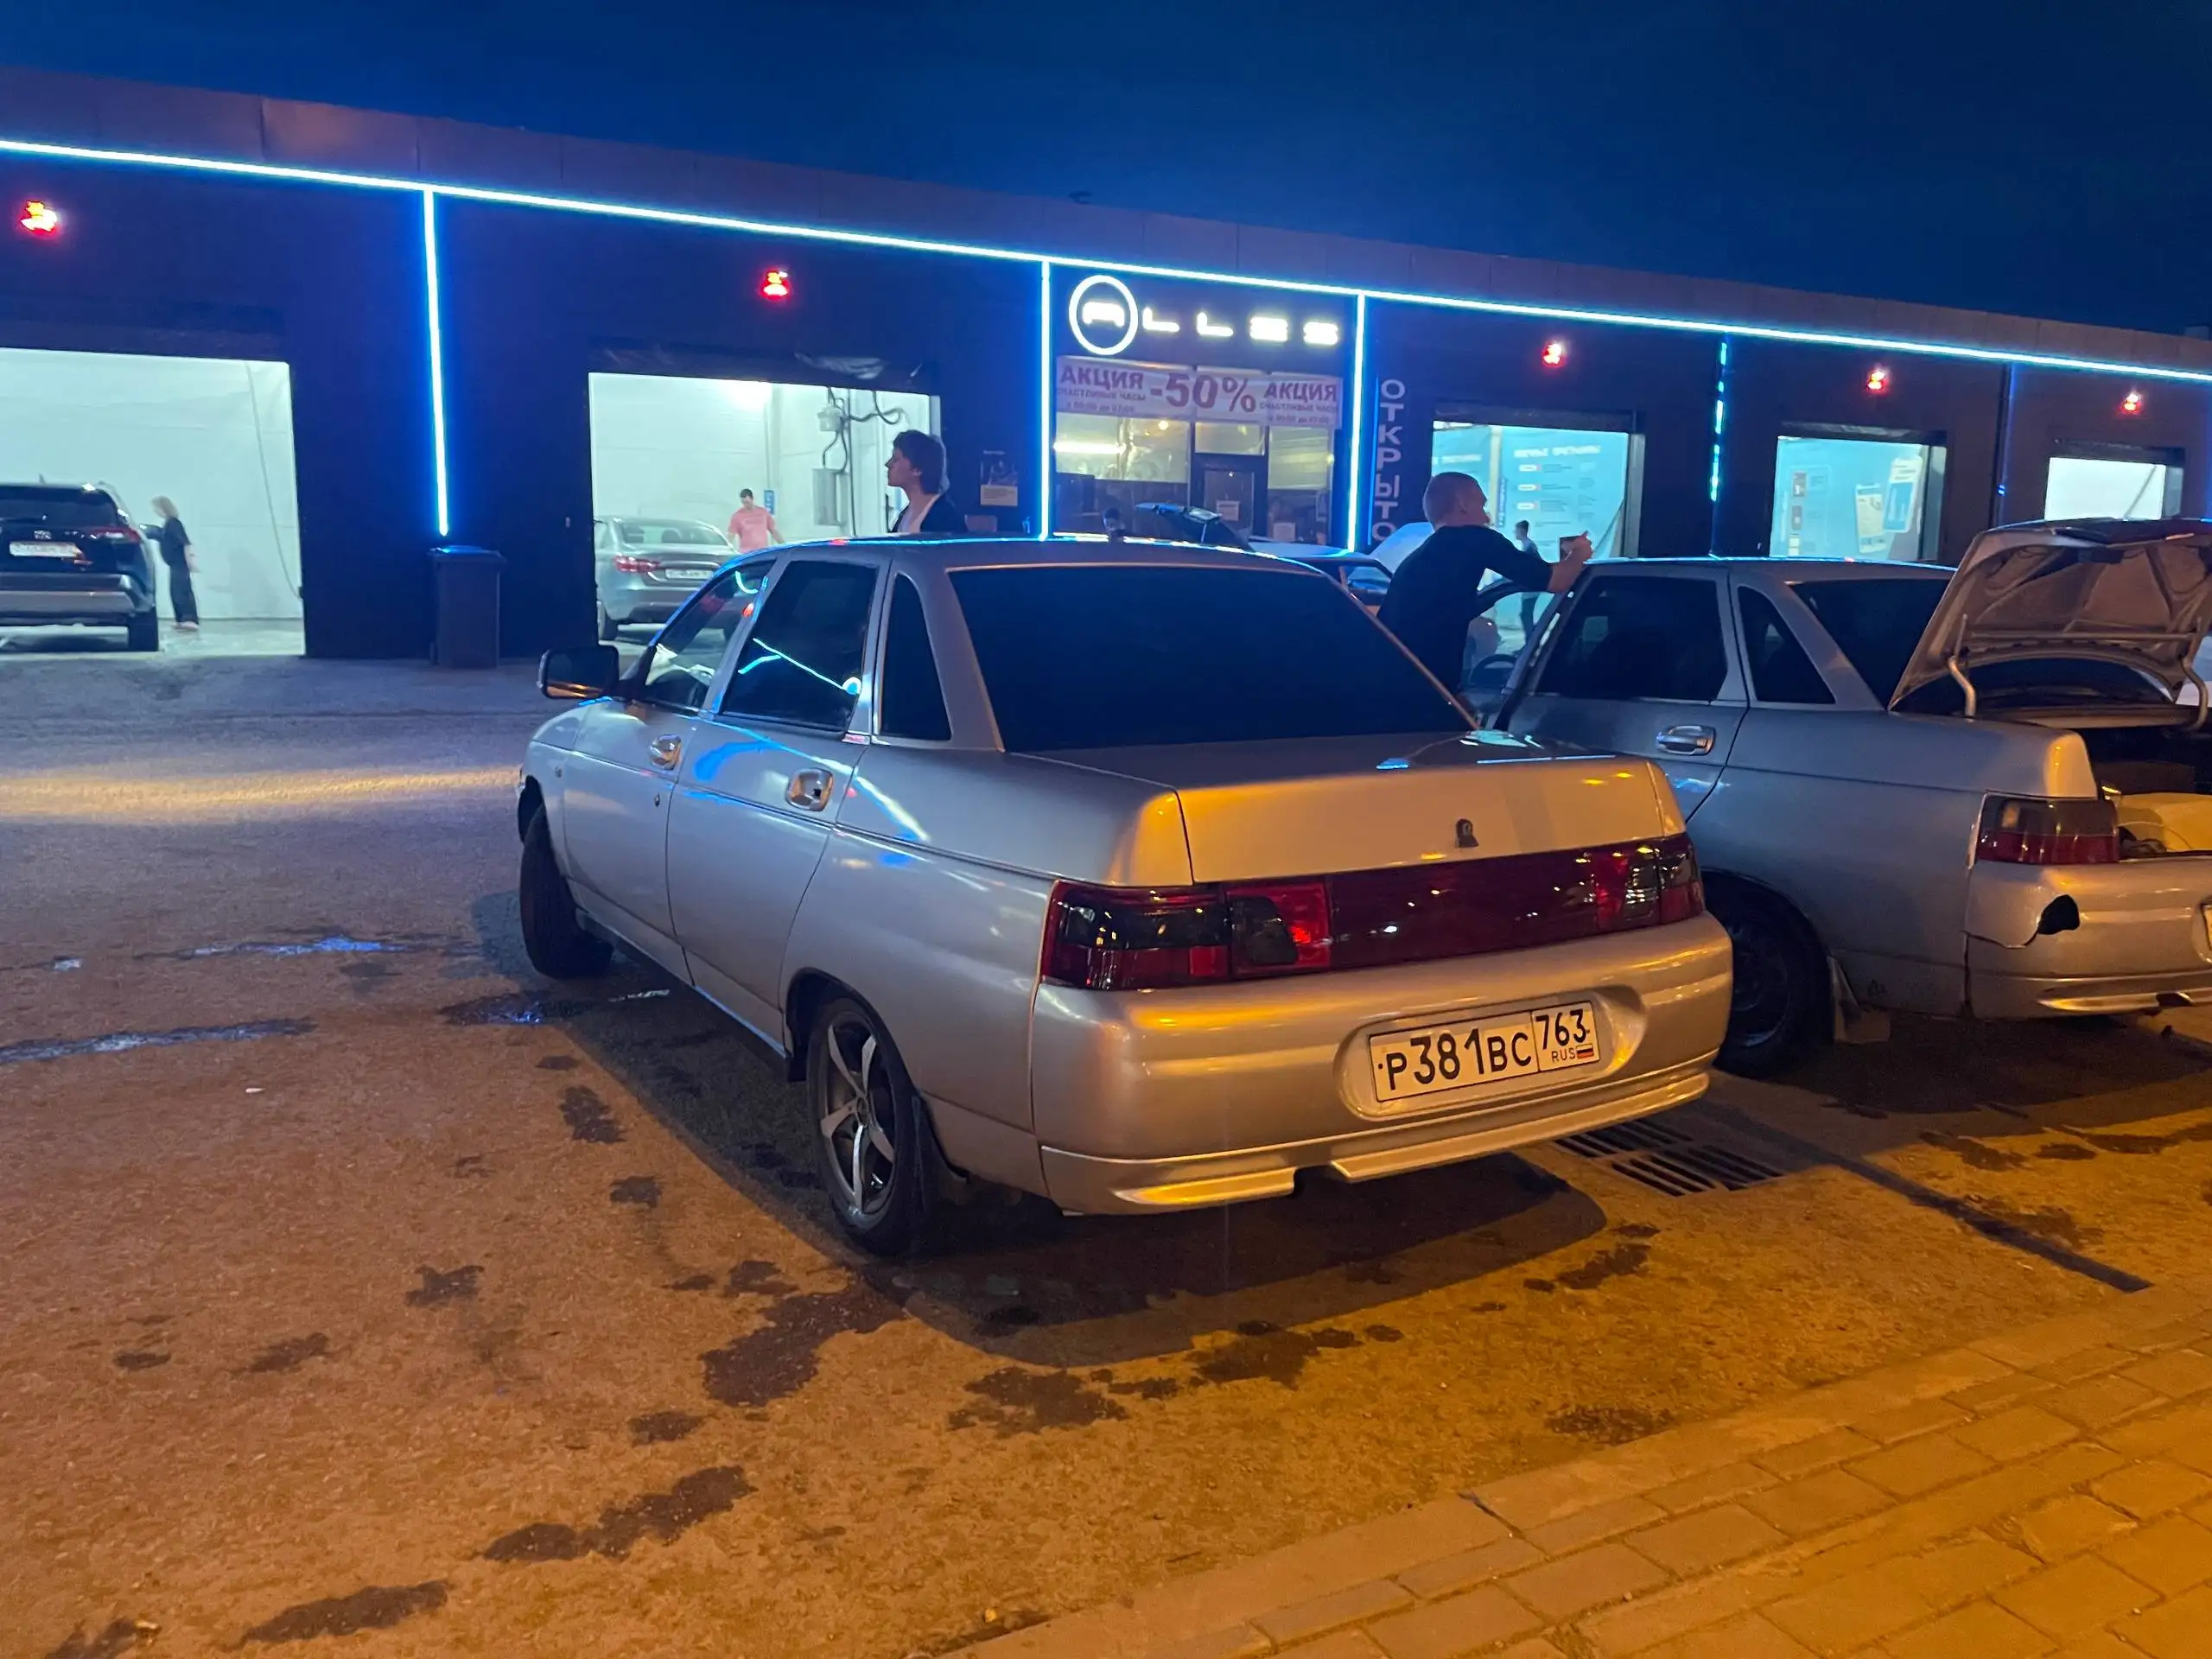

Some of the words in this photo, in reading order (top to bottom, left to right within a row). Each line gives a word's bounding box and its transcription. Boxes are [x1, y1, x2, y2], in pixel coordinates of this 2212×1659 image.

[1060, 365, 1144, 390] АКЦИЯ
[1150, 372, 1256, 413] -50%
[1263, 382, 1338, 404] АКЦИЯ
[1372, 378, 1406, 542] ОТКРЫТО
[1386, 1027, 1532, 1090] Р381ВС
[1535, 1008, 1586, 1051] 763
[1552, 1048, 1576, 1064] RUS
